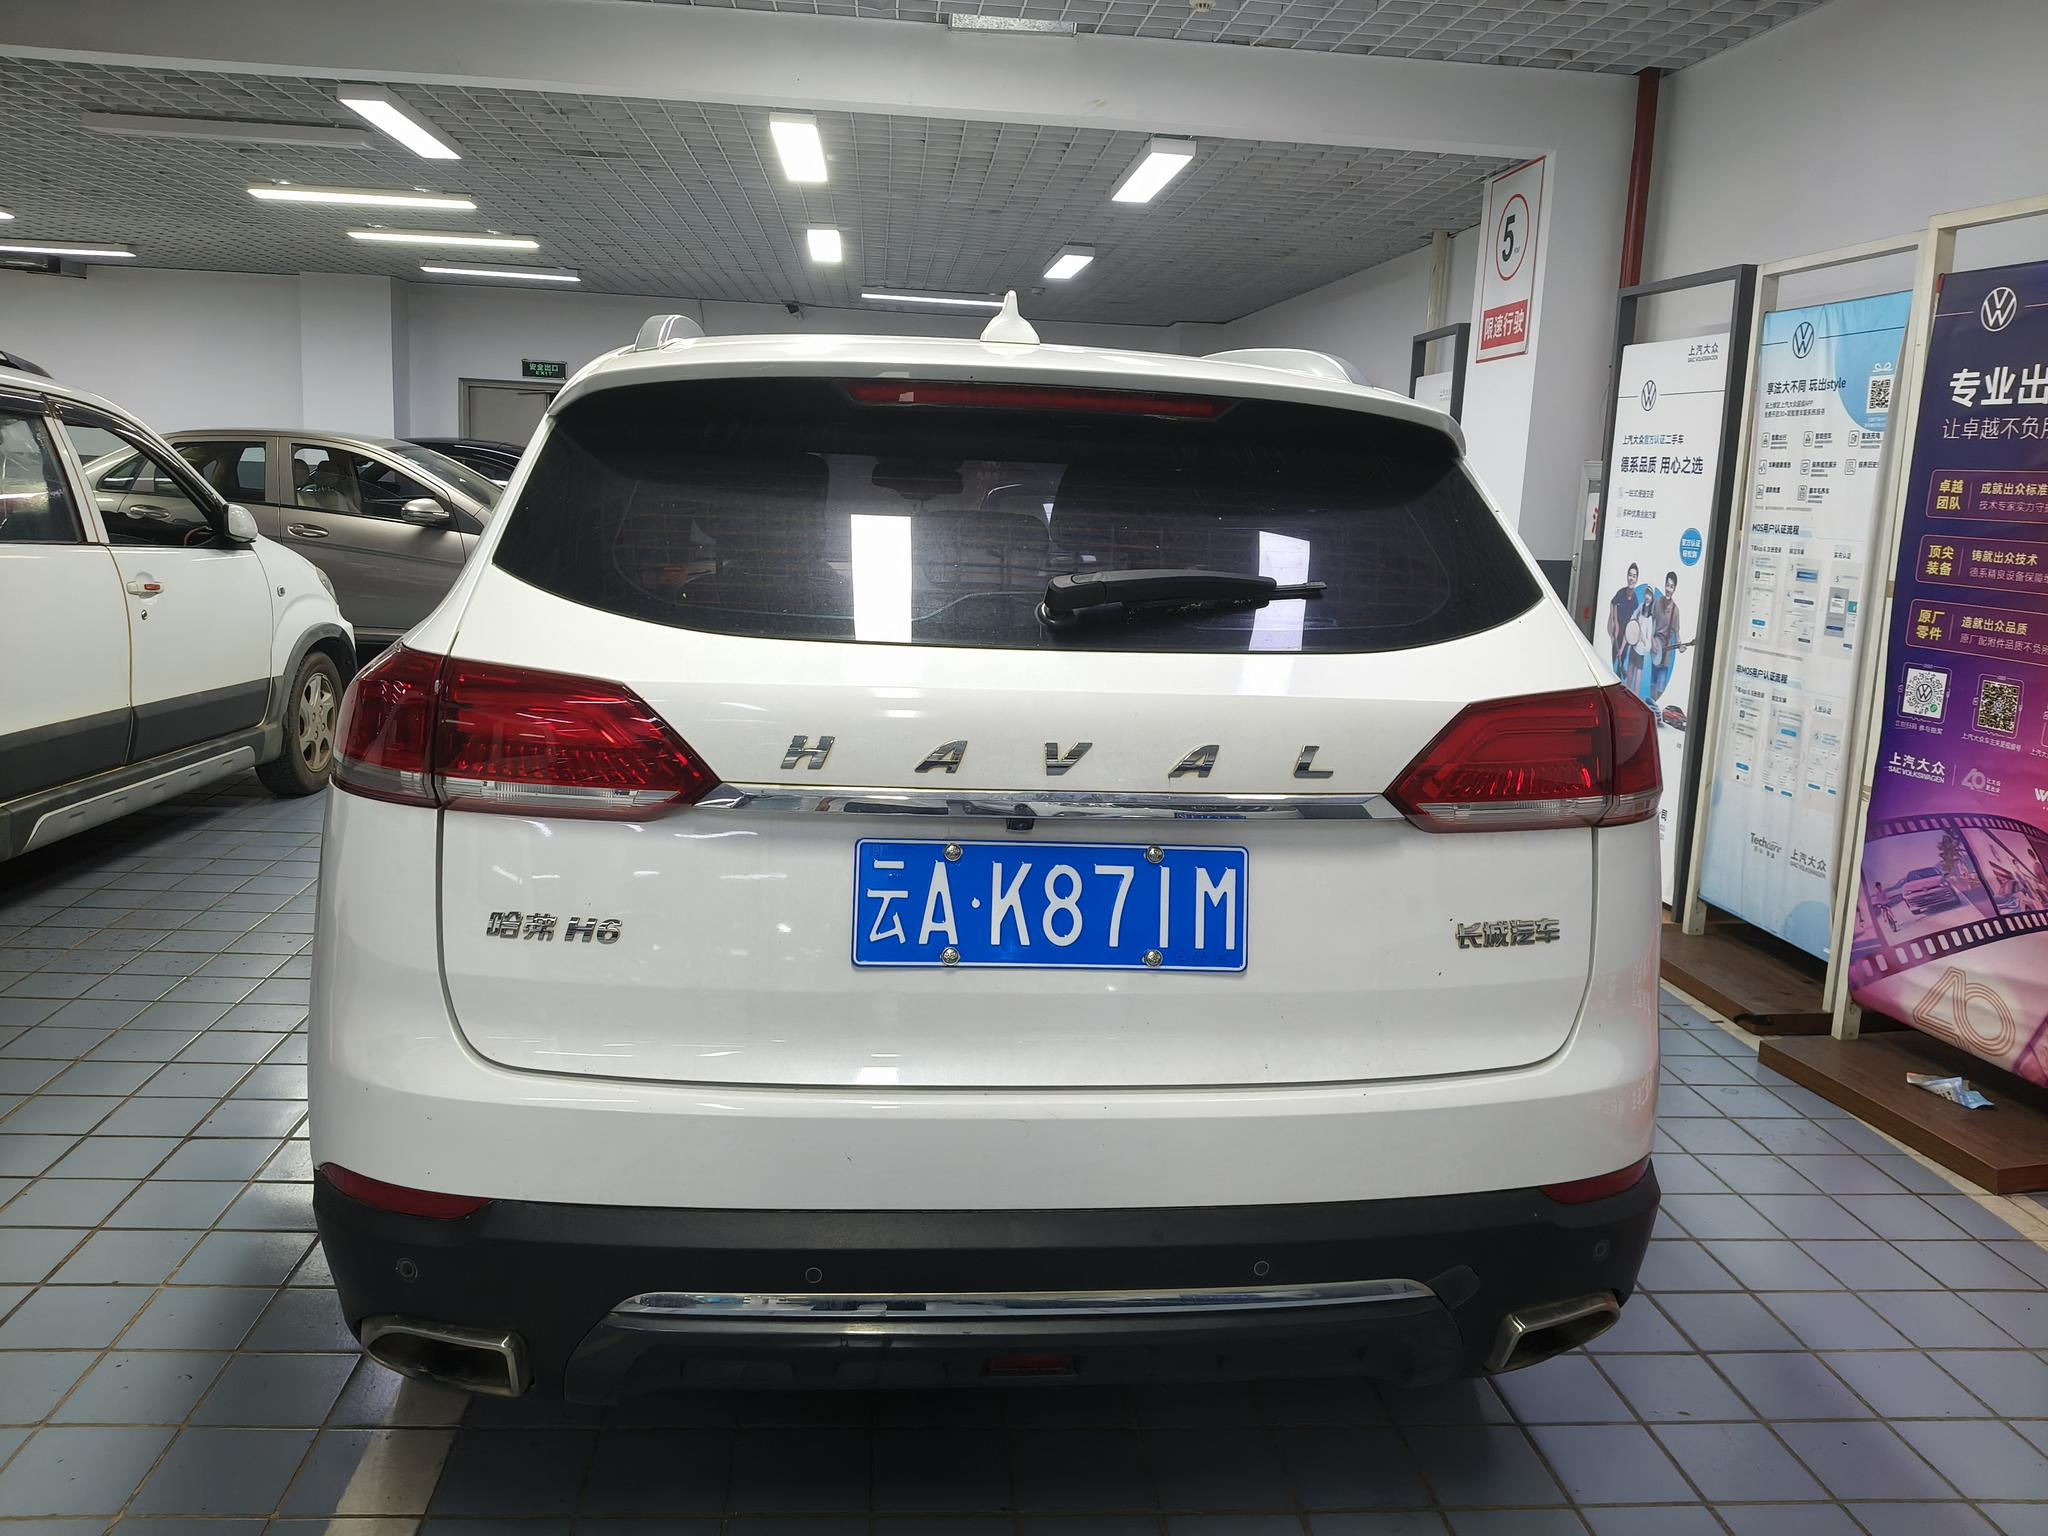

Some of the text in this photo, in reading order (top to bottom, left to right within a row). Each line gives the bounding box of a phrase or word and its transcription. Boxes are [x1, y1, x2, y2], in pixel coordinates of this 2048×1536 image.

[1502, 214, 1516, 262] 5
[1483, 310, 1525, 341] 限速行驶
[1688, 342, 1719, 356] 上汽大众
[529, 363, 558, 371] 安全出口
[1621, 456, 1703, 474] 德系品质 用心之选
[1938, 479, 1964, 494] 卓越
[1980, 482, 2048, 496] 成就出众标准
[1936, 496, 1961, 510] 团队
[1928, 545, 1954, 560] 顶尖
[1971, 549, 2038, 566] 铸就出众技术
[1926, 561, 1952, 577] 装备
[1918, 609, 1945, 624] 原厂
[1916, 625, 1942, 641] 零件
[1961, 616, 2028, 636] 造就出众品质
[780, 735, 1334, 779] HAVAL
[1889, 752, 1945, 776] 上汽大众
[1790, 848, 1827, 872] 上汽大众
[867, 860, 1236, 950] 云A·K871M
[486, 911, 622, 945] 哈弗 H6
[1455, 918, 1560, 949] 长城汽车
